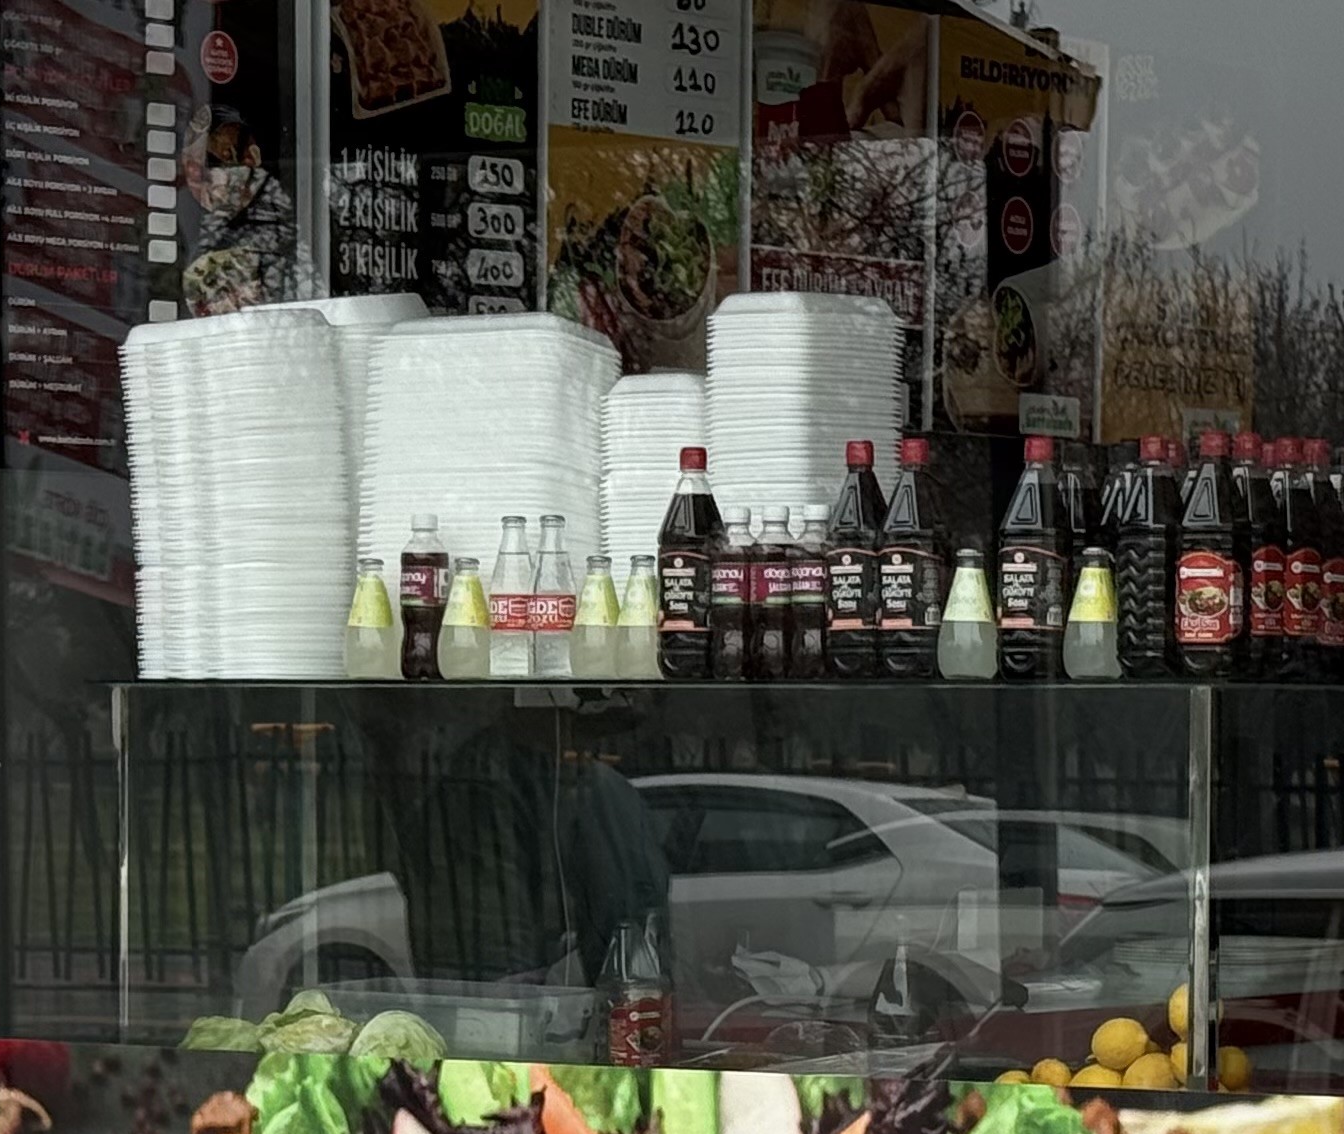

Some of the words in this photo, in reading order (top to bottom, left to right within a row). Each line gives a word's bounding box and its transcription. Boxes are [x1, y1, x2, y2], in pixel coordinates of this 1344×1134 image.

[606, 16, 642, 43] DÜRÜM
[672, 23, 720, 54] 130
[572, 55, 600, 79] MEGA
[602, 57, 638, 84] DÜRÜM
[673, 66, 715, 94] 110
[469, 107, 523, 138] DOĞAL
[572, 98, 590, 119] EFE
[592, 98, 627, 125] DÜRÜM
[675, 110, 714, 135] 120
[341, 147, 349, 179] 1
[357, 143, 418, 188] KİŞİLİK
[356, 195, 419, 235] KİŞİLİK
[474, 207, 516, 235] 300
[340, 243, 350, 275] 3
[356, 238, 419, 283] KİŞİLİK
[477, 256, 513, 281] 400
